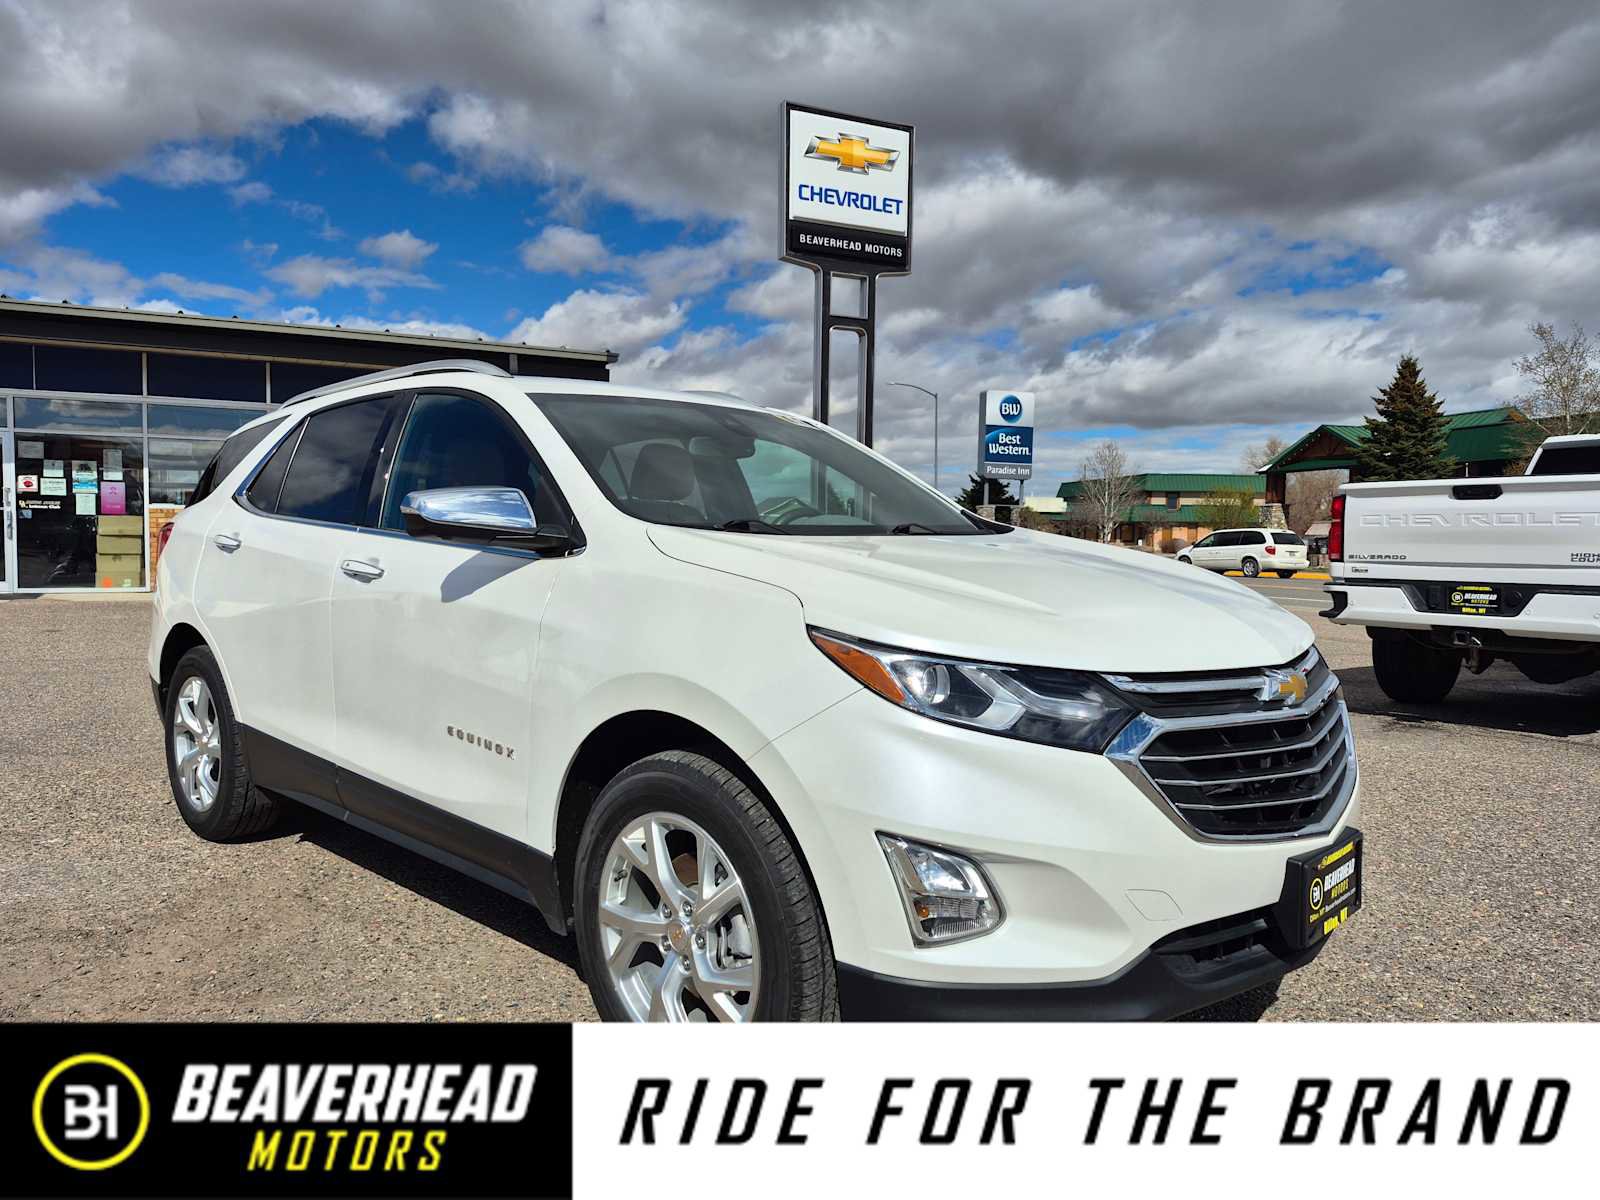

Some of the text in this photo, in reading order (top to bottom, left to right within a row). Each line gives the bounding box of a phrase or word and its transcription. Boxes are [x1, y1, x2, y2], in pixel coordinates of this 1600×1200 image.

[798, 183, 903, 215] CHEVROLET
[799, 233, 903, 258] BEAVERHEAD MOTORS
[1001, 403, 1020, 416] BW
[999, 432, 1021, 445] Best
[986, 465, 1030, 476] Paradise Inn
[446, 725, 515, 761] EQUINOX
[1324, 858, 1355, 891] BEAVERHEAD
